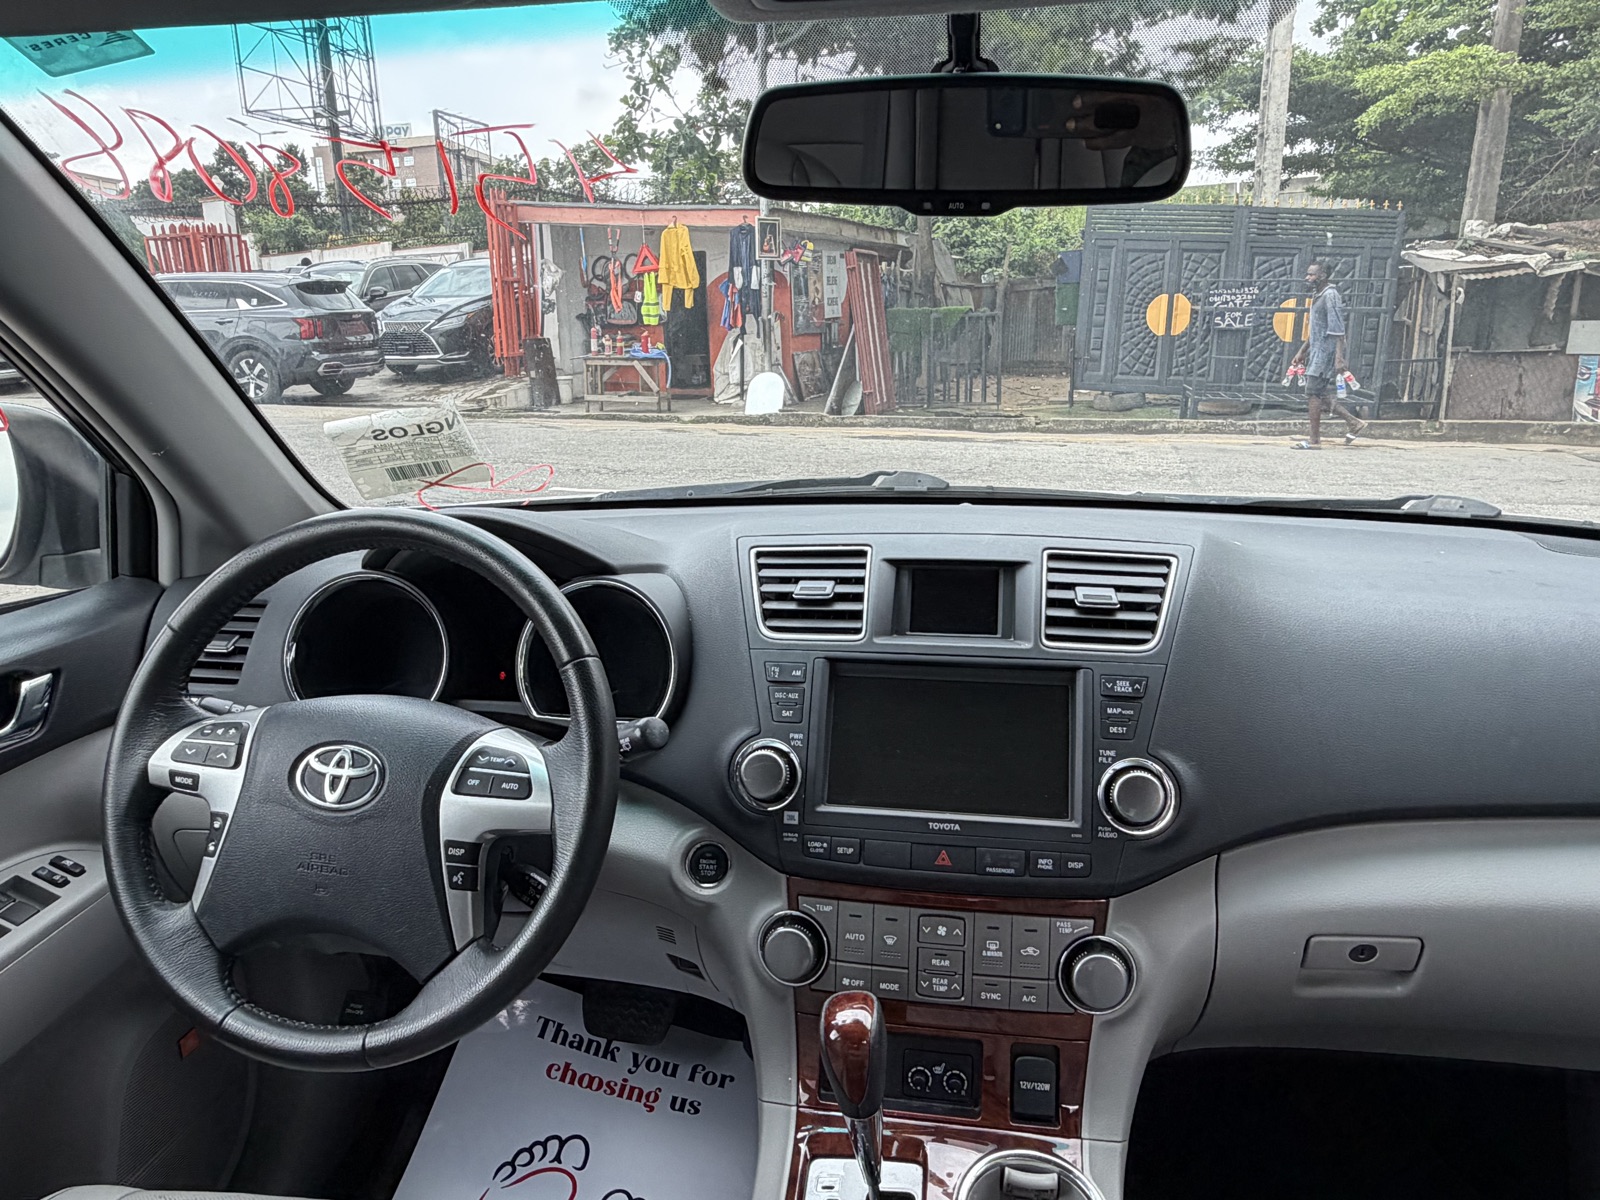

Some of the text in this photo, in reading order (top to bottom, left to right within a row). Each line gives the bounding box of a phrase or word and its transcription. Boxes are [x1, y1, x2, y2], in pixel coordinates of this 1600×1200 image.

[1214, 312, 1254, 328] SALE
[1109, 726, 1127, 734] DEST
[1099, 749, 1117, 757] TUNE
[490, 755, 505, 763] TEMP
[174, 776, 194, 785] MODE
[467, 778, 519, 790] OFF AUTO
[928, 822, 961, 831] TOYOTA
[1097, 831, 1118, 839] AUDIO
[447, 847, 466, 857] DISP
[836, 846, 854, 855] SETUP
[296, 861, 349, 877] AIRBAG
[1067, 861, 1084, 869] DISP
[816, 904, 833, 912] TEMP
[845, 933, 865, 941] AUTO
[931, 959, 950, 967] REAR
[851, 979, 900, 991] OFF MODE
[933, 984, 948, 992] TEMP
[980, 992, 1037, 1003] SYNC A/C
[536, 1015, 735, 1090] Thank you for
[545, 1061, 702, 1116] choosing us
